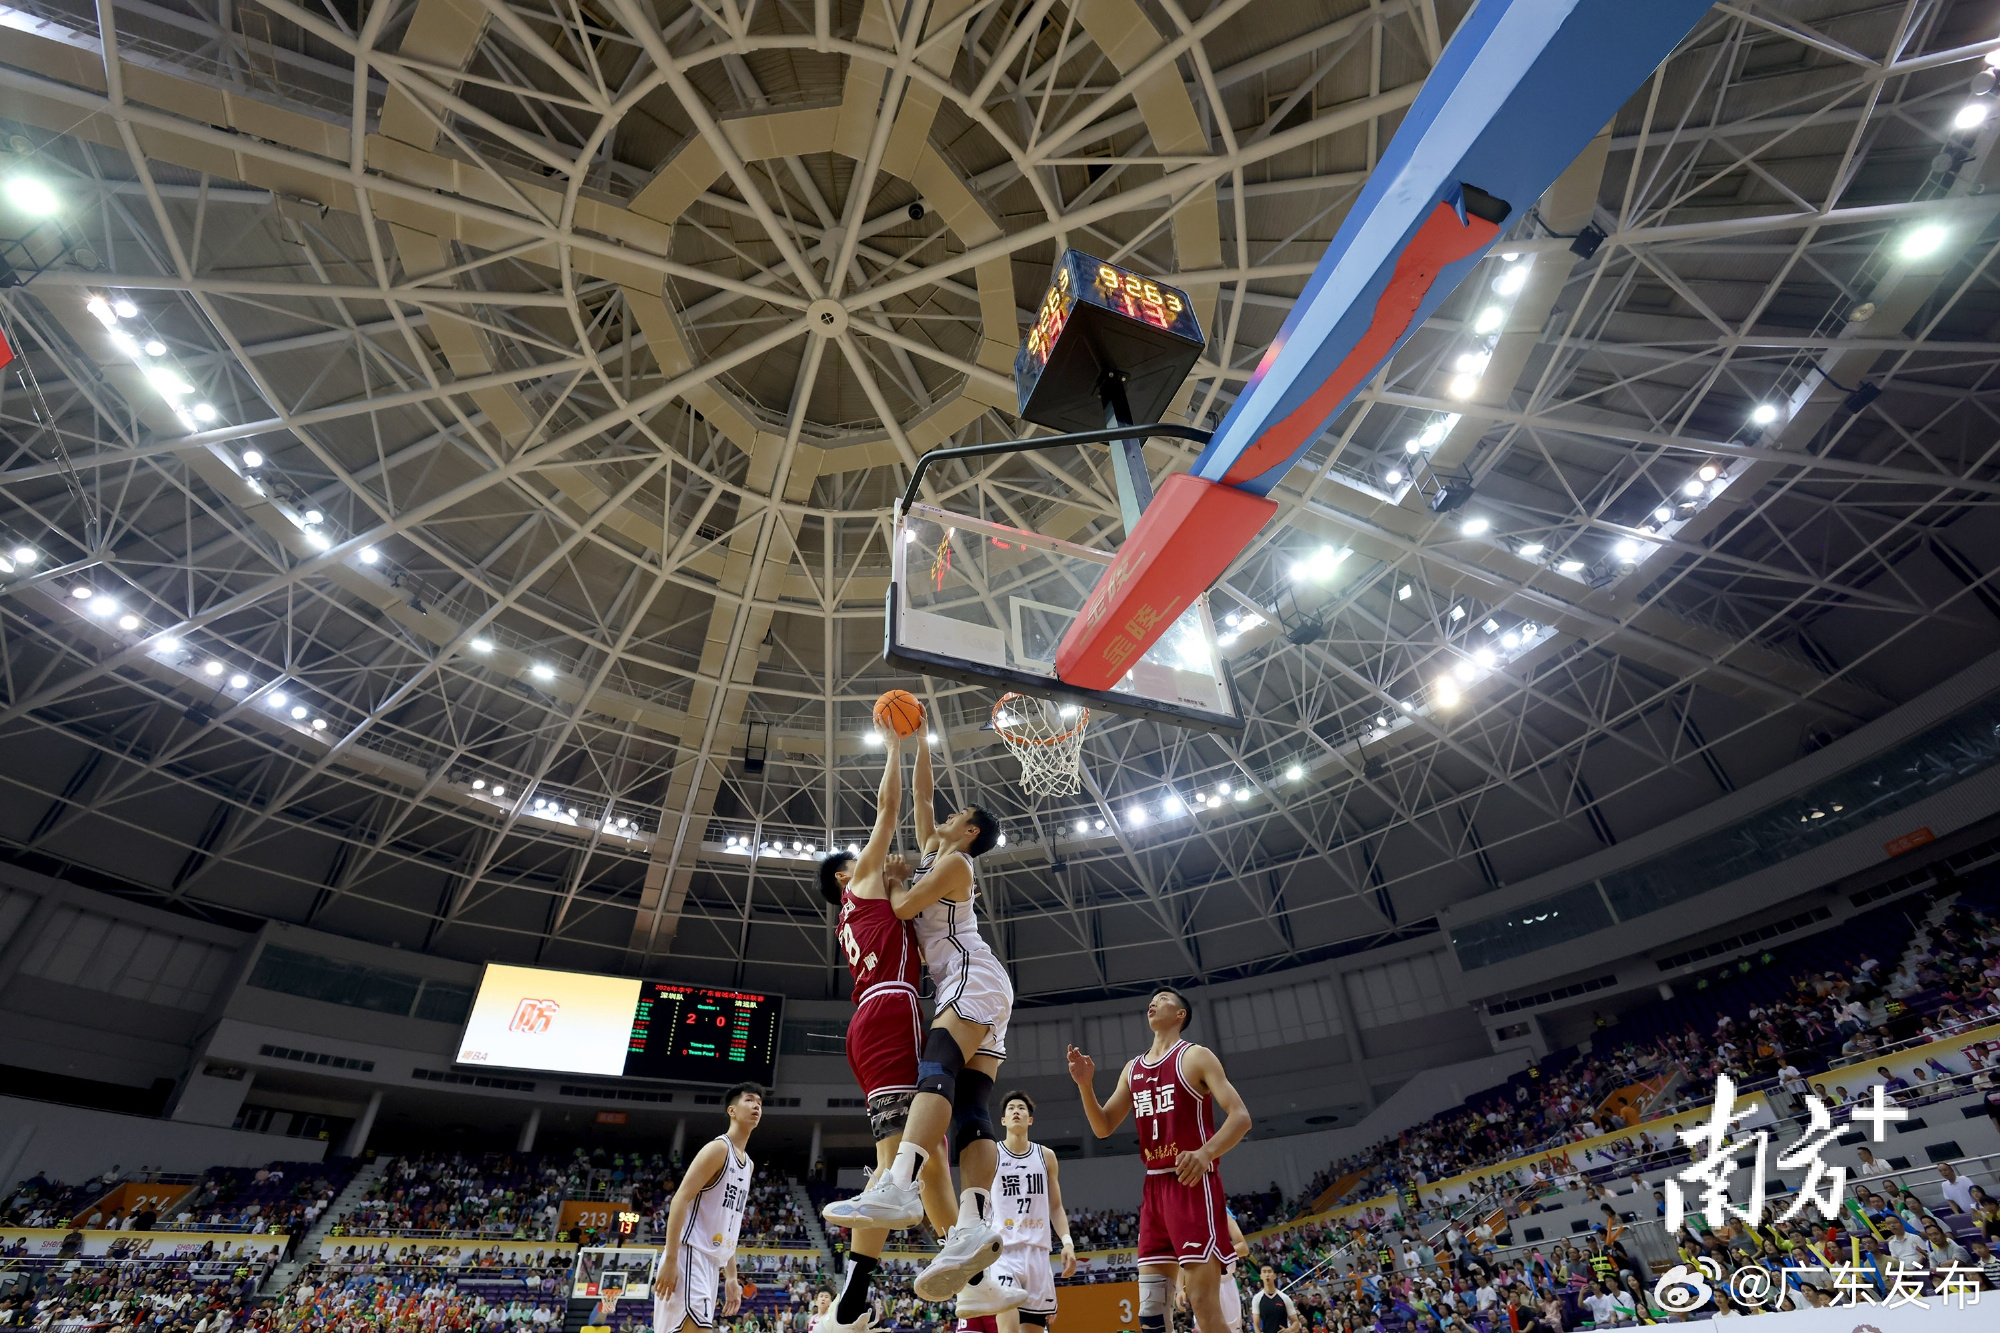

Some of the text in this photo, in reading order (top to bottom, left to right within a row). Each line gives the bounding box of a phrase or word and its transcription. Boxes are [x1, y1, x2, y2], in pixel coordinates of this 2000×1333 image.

[510, 998, 560, 1034] 防
[686, 1013, 696, 1024] 2
[716, 1016, 726, 1027] 0
[877, 1094, 896, 1108] THE
[1132, 1083, 1175, 1118] 清远
[879, 1108, 898, 1123] THE
[1001, 1173, 1044, 1196] 深圳
[1017, 1198, 1031, 1214] 77
[579, 1212, 607, 1226] 213
[620, 1222, 632, 1234] 13
[998, 1276, 1013, 1287] 77
